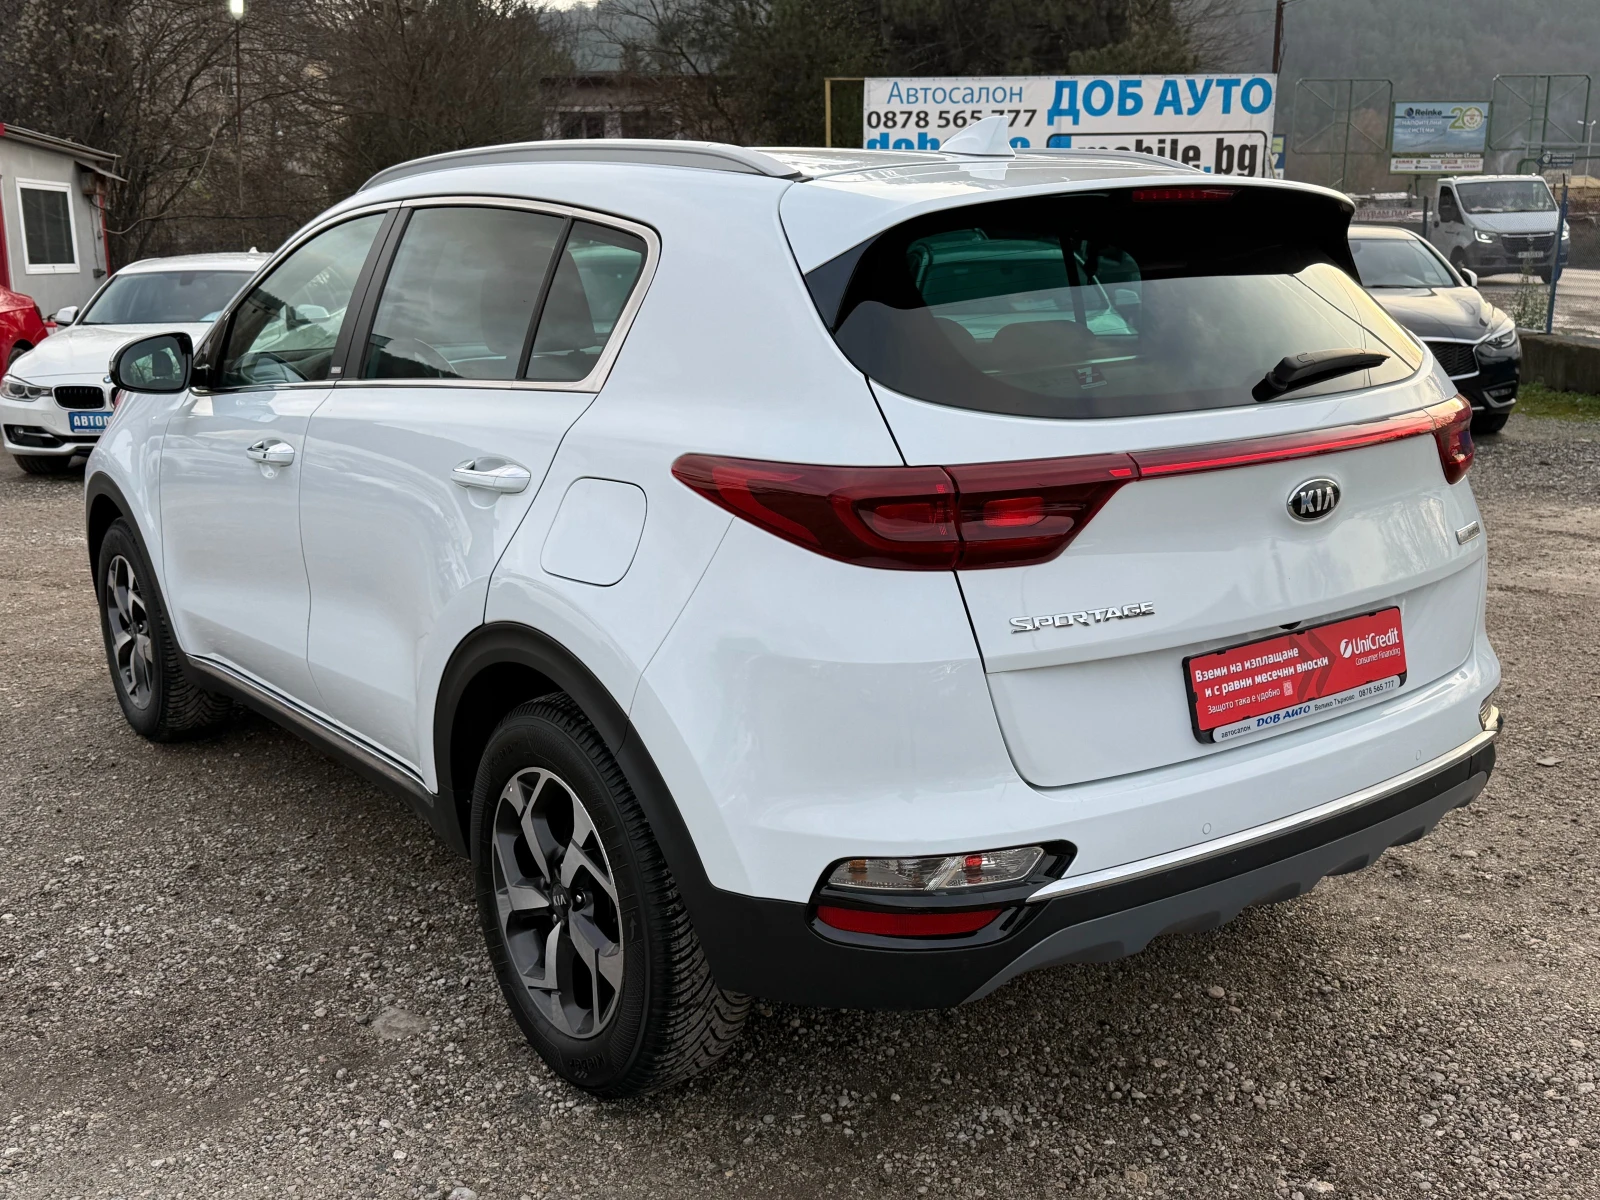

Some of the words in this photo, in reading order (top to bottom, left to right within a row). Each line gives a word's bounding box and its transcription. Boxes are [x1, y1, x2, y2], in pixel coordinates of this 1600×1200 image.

[887, 81, 1023, 104] Автосалон
[1047, 79, 1144, 126] ДОБ
[1153, 77, 1273, 116] АУТО
[867, 111, 930, 129] 0878
[937, 110, 983, 128] 565
[1415, 109, 1443, 117] Reinke
[1299, 486, 1335, 514] KIA
[1009, 601, 1155, 634] SPORTAGE
[1353, 627, 1400, 655] UniCredit
[1195, 665, 1228, 682] Вземи
[1230, 662, 1242, 674] на
[1244, 647, 1299, 670] изплащане
[1355, 653, 1378, 665] Consumer
[1379, 647, 1400, 659] Financing
[1205, 687, 1212, 697] и
[1214, 685, 1220, 695] с
[1222, 676, 1253, 696] равни
[1254, 665, 1295, 685] месечни
[1296, 656, 1329, 674] вноски
[1359, 687, 1373, 697] 0878
[1373, 683, 1384, 693] 565
[1384, 680, 1395, 690] 777
[1207, 703, 1234, 714] Защото
[1235, 697, 1250, 706] така
[1256, 688, 1281, 702] удобно
[1314, 701, 1333, 711] Велико
[1256, 713, 1281, 727] DOB
[1283, 704, 1311, 720] AUTO
[1221, 725, 1251, 738] автосалон
[552, 894, 567, 907] KIA
